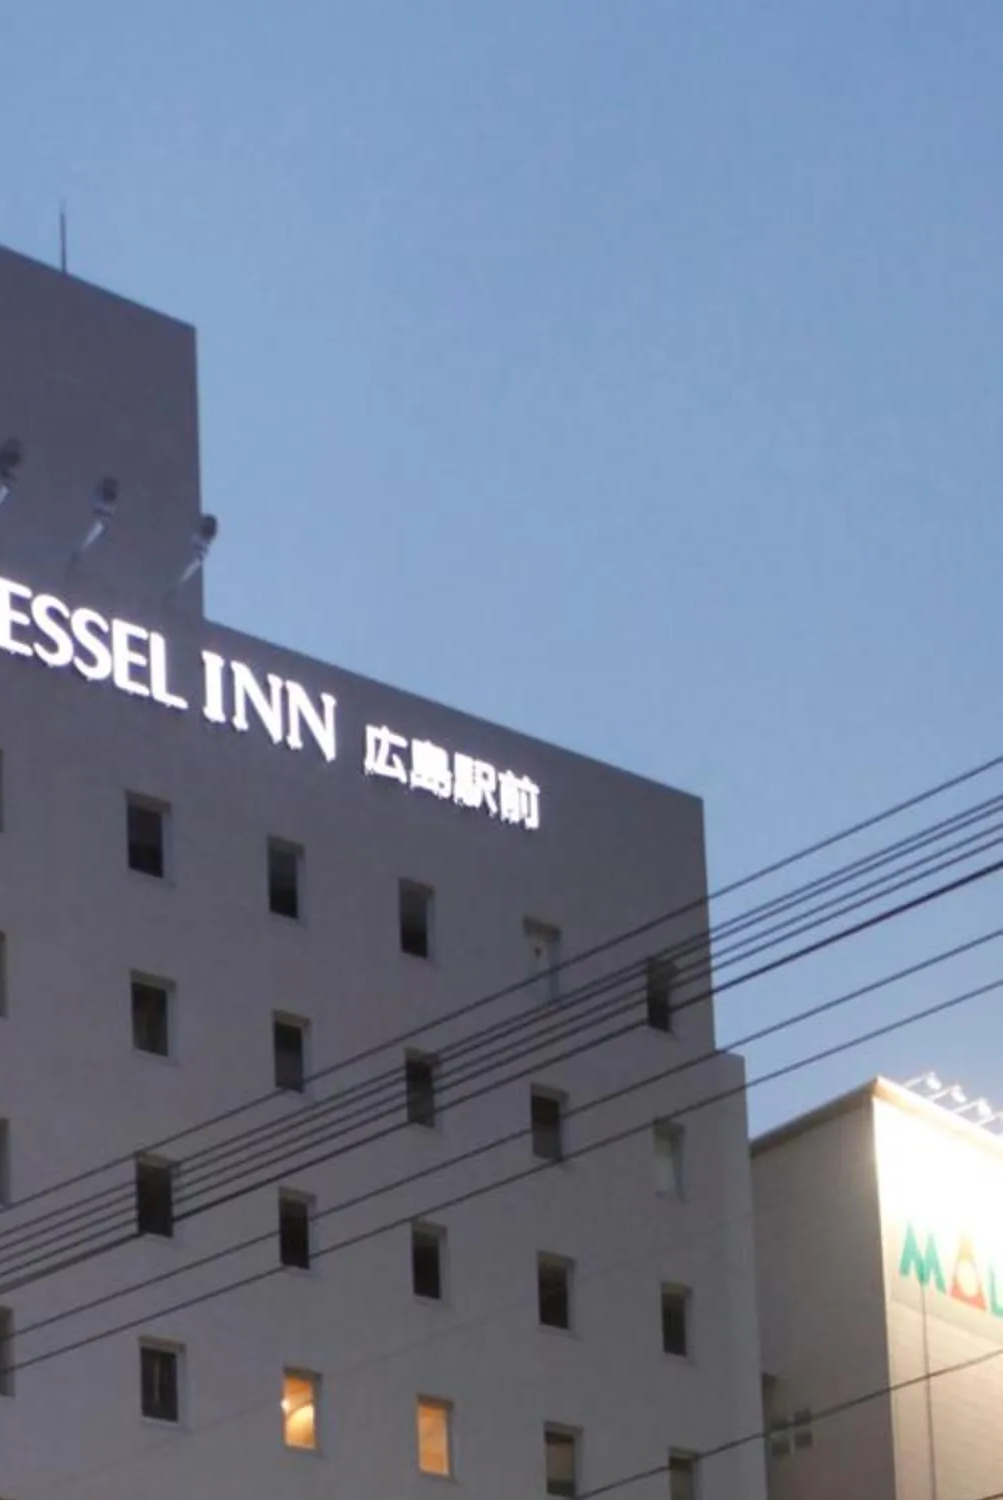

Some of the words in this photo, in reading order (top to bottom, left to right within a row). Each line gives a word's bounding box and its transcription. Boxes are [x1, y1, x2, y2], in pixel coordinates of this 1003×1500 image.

[201, 650, 337, 762] INN
[363, 724, 541, 829] 広島駅前
